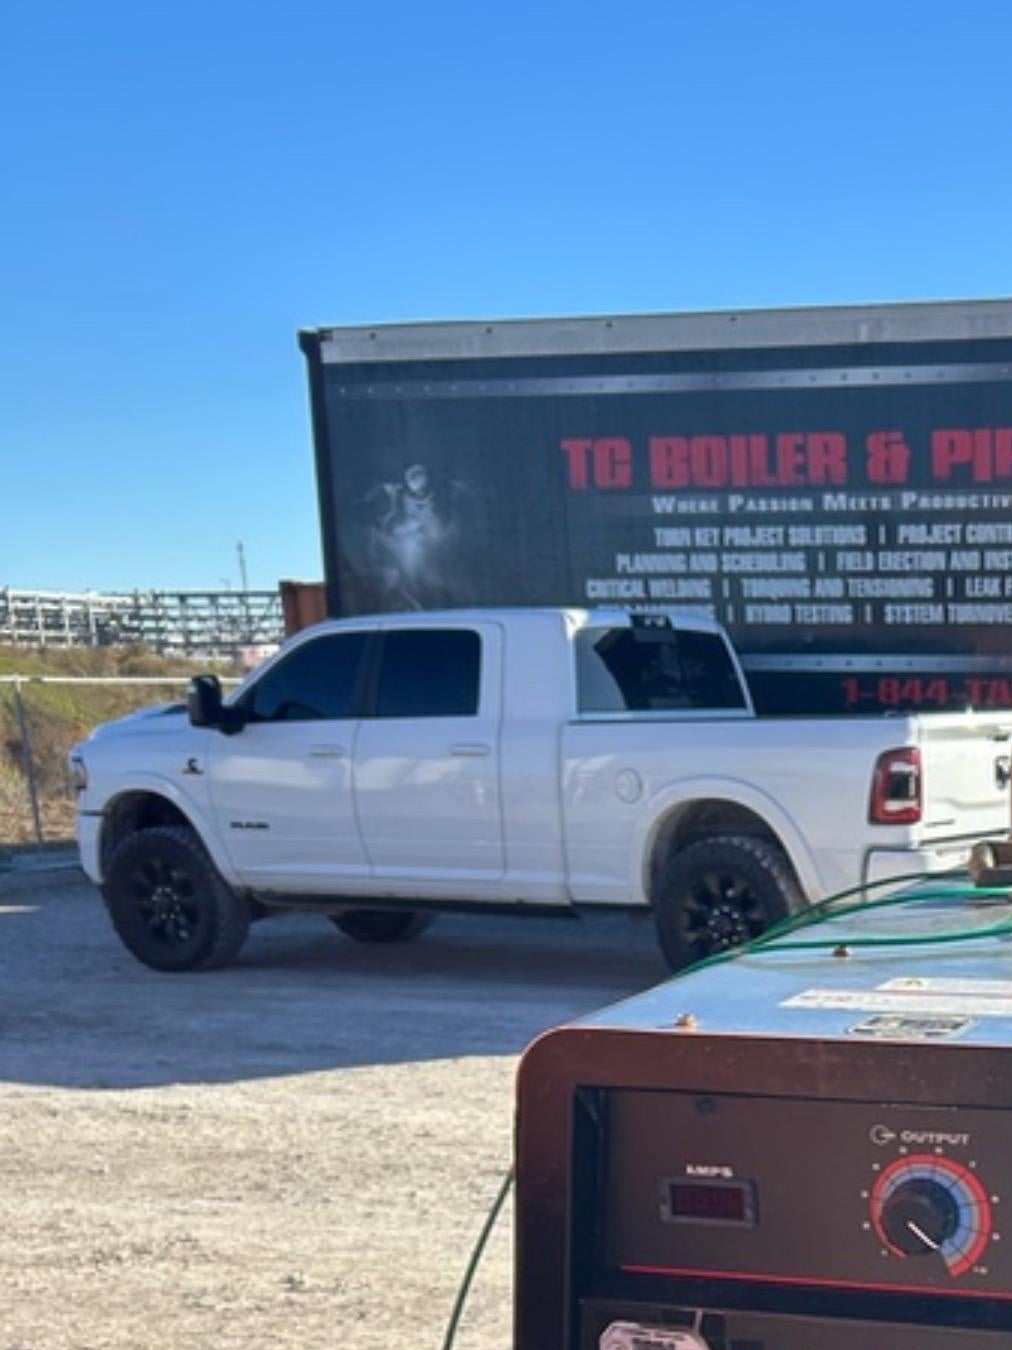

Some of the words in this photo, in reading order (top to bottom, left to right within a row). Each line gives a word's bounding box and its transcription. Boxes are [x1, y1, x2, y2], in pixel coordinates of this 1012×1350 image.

[650, 431, 847, 488] BOILER
[866, 430, 911, 483] &
[723, 526, 784, 546] PROJECT
[788, 524, 867, 545] SOLUTIONS
[897, 523, 962, 544] PROJECT
[616, 554, 687, 573] PLANNING
[689, 553, 718, 573] AND
[721, 552, 806, 573] SCHEDULING
[836, 551, 874, 571] FIELD
[878, 550, 946, 571] ERECTION
[950, 550, 980, 570] AND
[586, 579, 646, 599] CRITICAL
[648, 578, 712, 598] WELDING
[814, 577, 845, 597] AND
[848, 576, 935, 597] TENSIONING
[965, 575, 1001, 597] LEAK
[795, 604, 853, 624] TESTING
[884, 603, 944, 623] SYSTEM
[900, 1130, 970, 1144] OUTPUT
